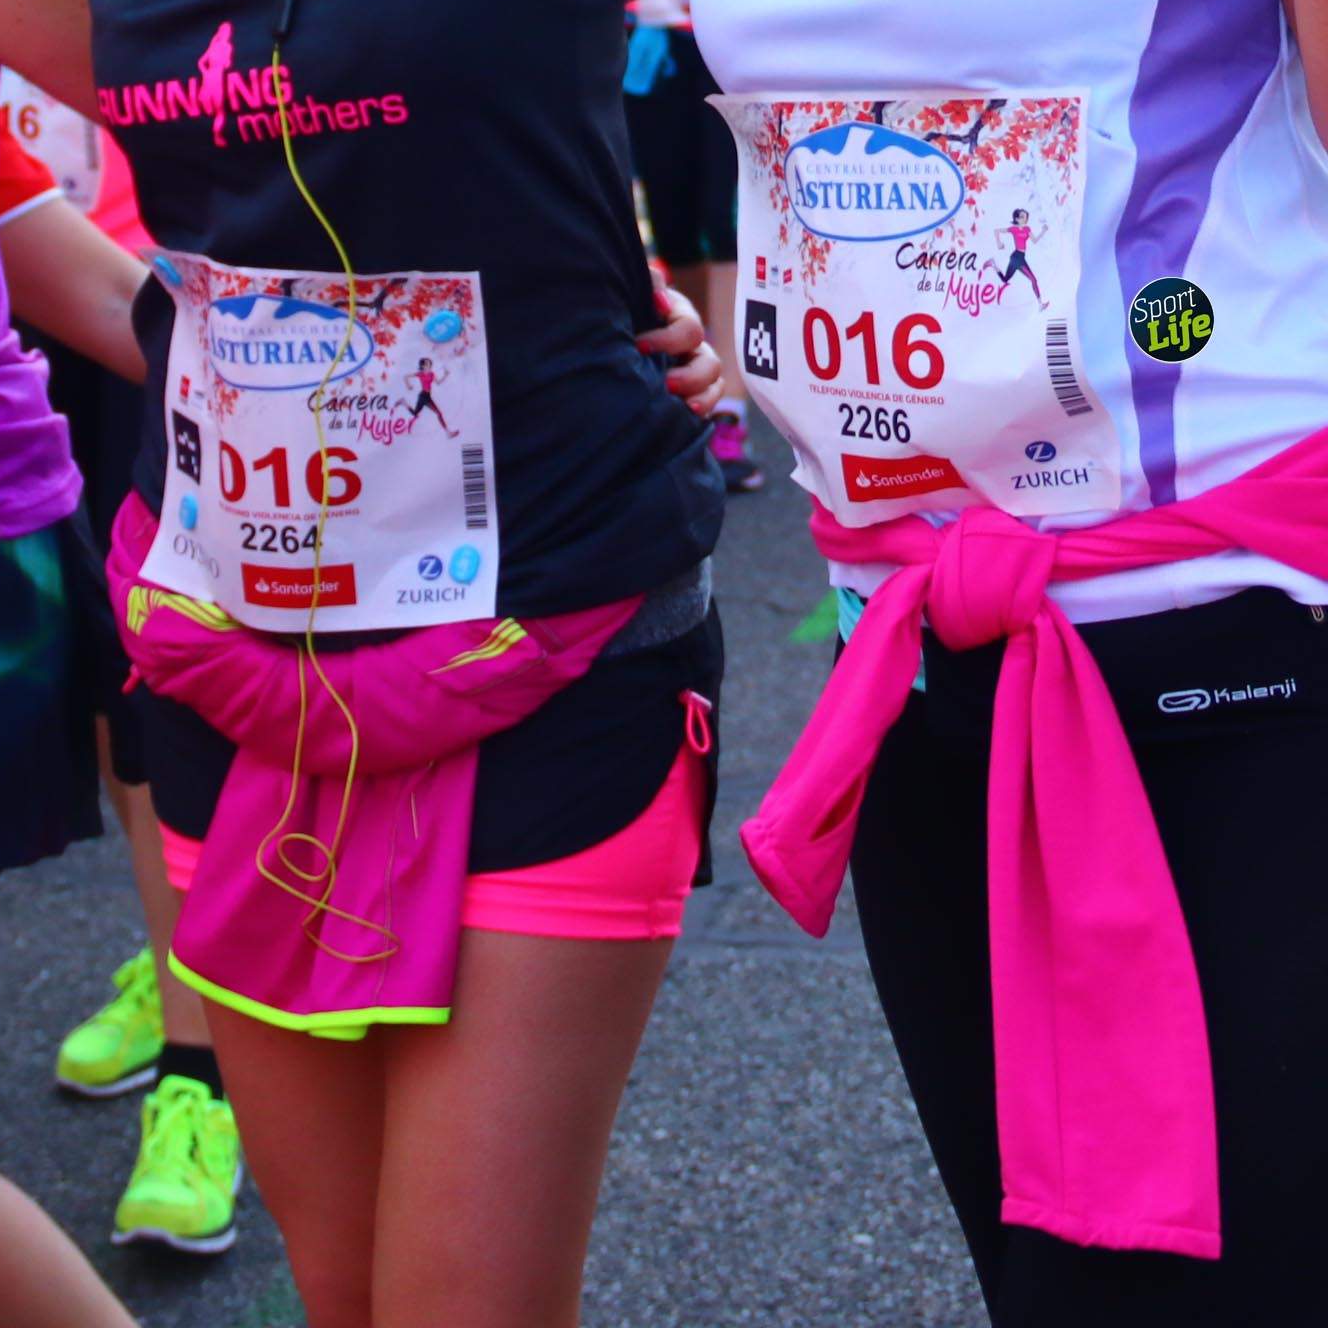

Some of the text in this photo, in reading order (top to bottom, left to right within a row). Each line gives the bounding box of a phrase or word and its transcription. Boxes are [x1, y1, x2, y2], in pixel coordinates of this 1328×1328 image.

[236, 94, 409, 144] mothers
[793, 165, 949, 211] ASTURIANA
[894, 241, 978, 272] Carrera
[917, 270, 1008, 318] de la Mujer
[1133, 286, 1197, 323] Sport
[802, 306, 946, 391] 016
[1147, 309, 1212, 353] Life
[307, 389, 390, 414] Carrera
[892, 393, 904, 403] DE
[328, 407, 418, 447] de la Mujer
[838, 402, 912, 445] 2266
[218, 440, 363, 509] 016
[871, 466, 946, 489] Santander
[1012, 467, 1090, 491] ZURICH
[239, 522, 323, 555] 2264
[397, 587, 466, 604] ZURICH
[1213, 677, 1297, 705] Kalenji
